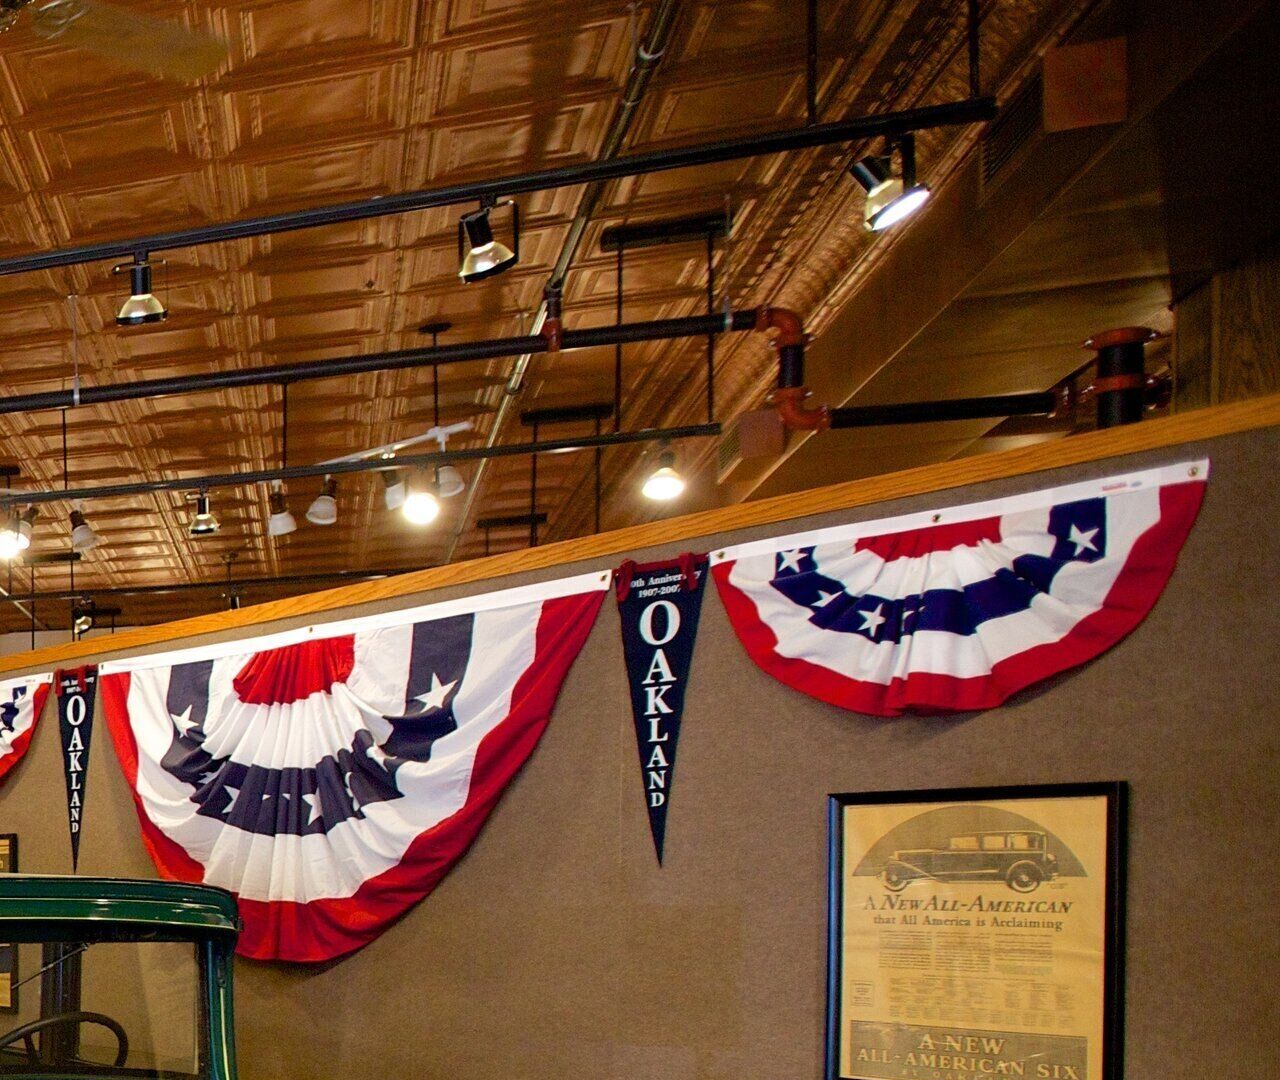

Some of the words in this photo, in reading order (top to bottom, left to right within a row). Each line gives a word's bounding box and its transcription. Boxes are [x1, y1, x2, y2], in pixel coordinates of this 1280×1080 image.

[639, 599, 681, 808] OAKLAND
[66, 694, 87, 833] OAKLAND
[864, 895, 875, 910] A
[873, 915, 896, 925] that
[901, 915, 917, 925] All
[923, 915, 970, 927] America
[976, 917, 986, 927] is
[991, 917, 1063, 931] Acclaiming
[918, 1034, 935, 1050] A
[946, 1035, 1005, 1055] NEW
[857, 1048, 1025, 1075] ALL-AMERICAN
[1037, 1064, 1081, 1080] SIX
